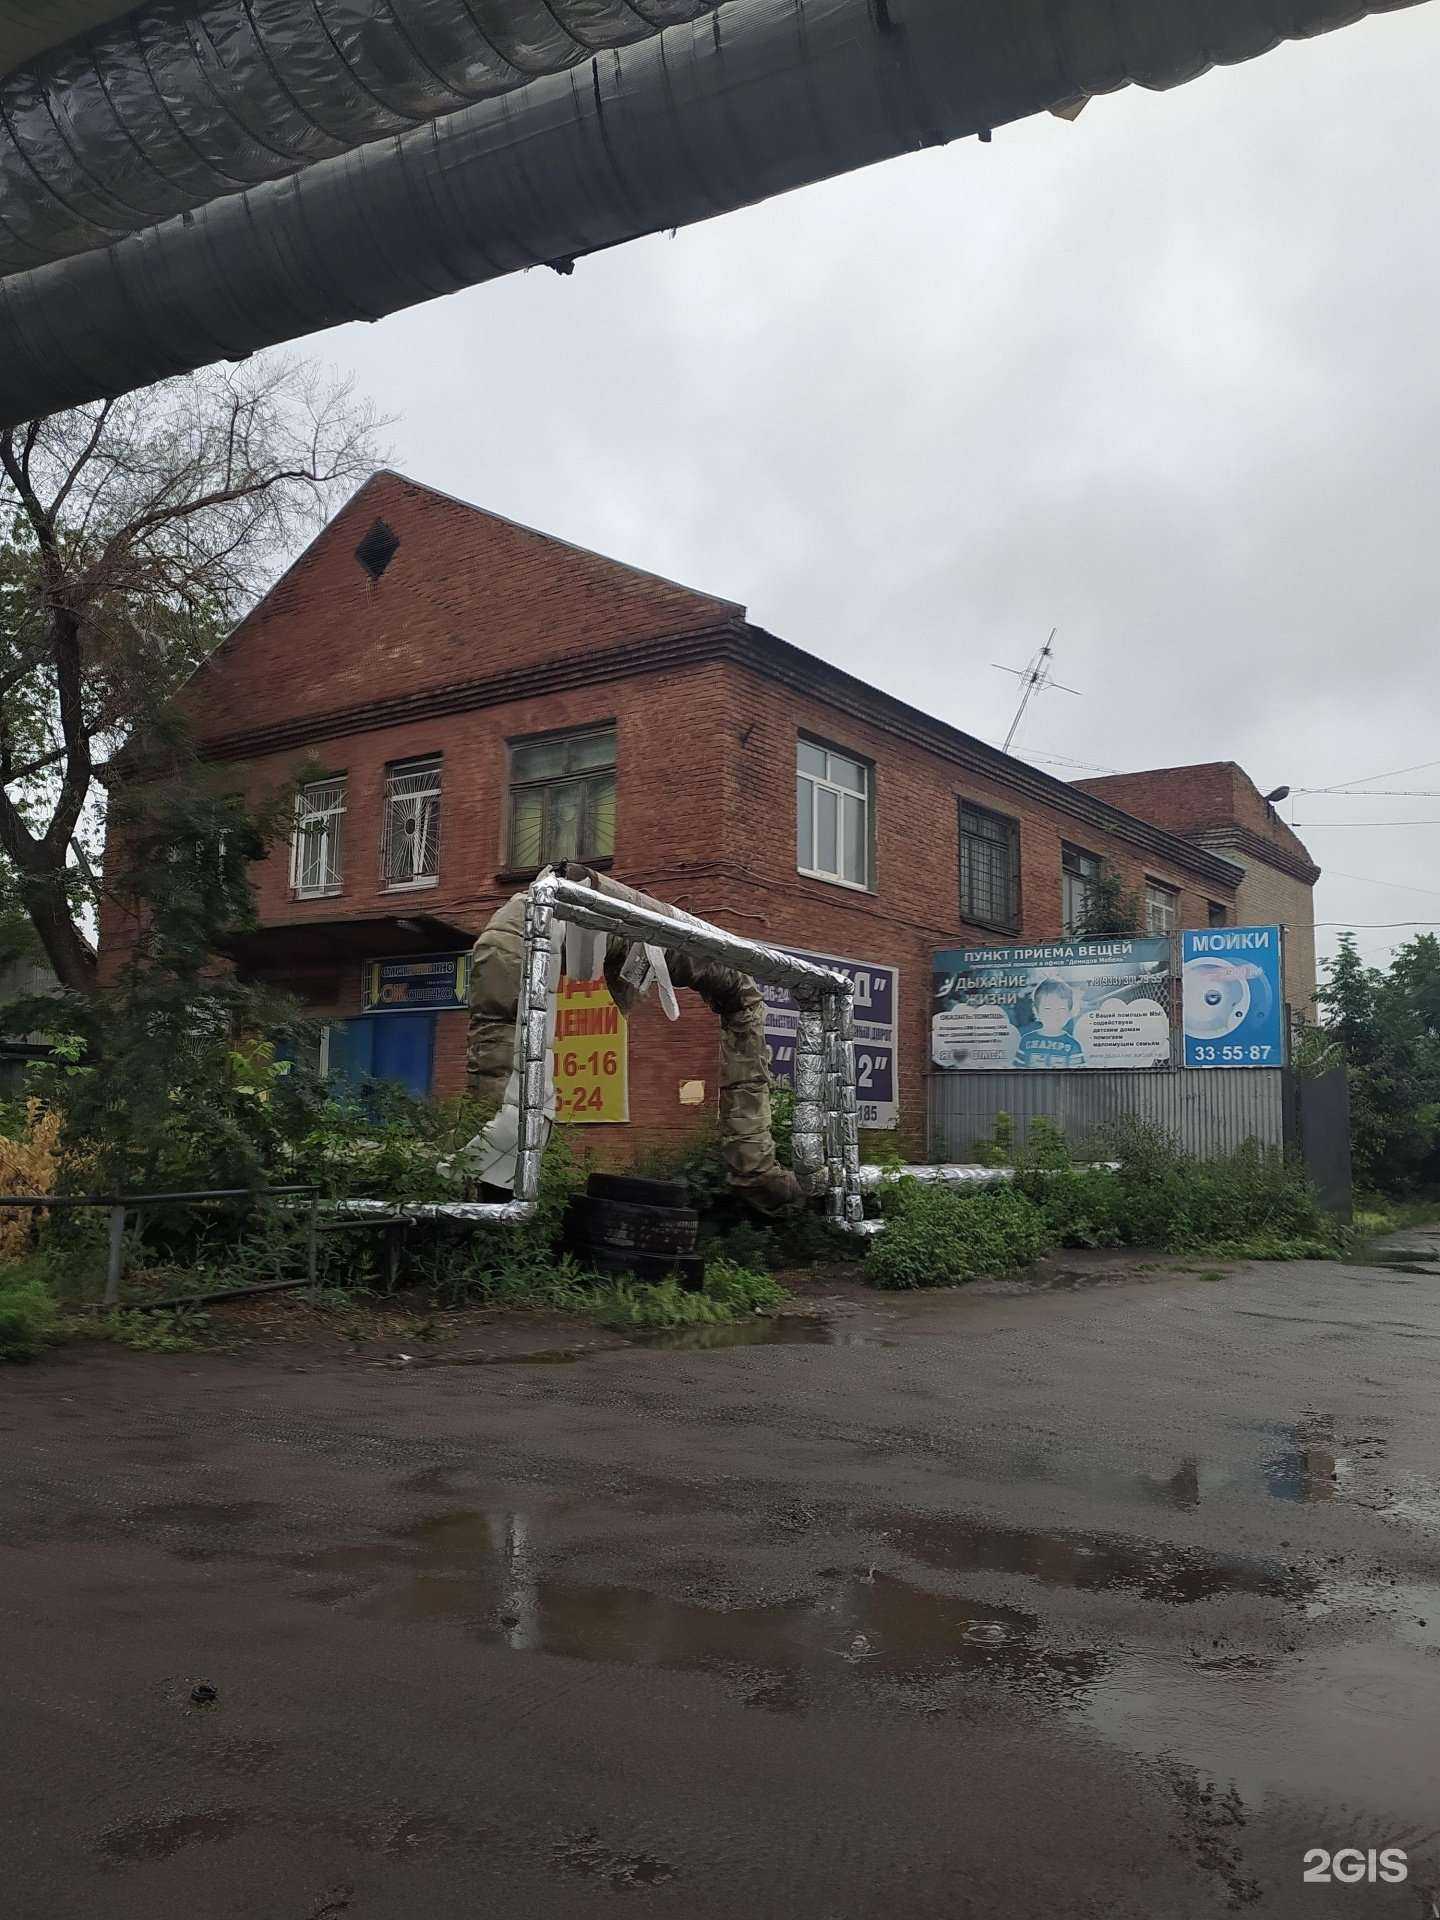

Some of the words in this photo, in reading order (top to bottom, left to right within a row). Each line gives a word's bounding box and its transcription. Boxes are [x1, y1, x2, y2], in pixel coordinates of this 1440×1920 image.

[964, 950, 1010, 962] ПУНКТ
[1014, 947, 1074, 960] ПРИЕМА
[1078, 941, 1133, 957] ВЕЩЕЙ
[955, 975, 1027, 992] ДЫХАНИЕ
[966, 992, 1018, 1006] ЖИЗНИ
